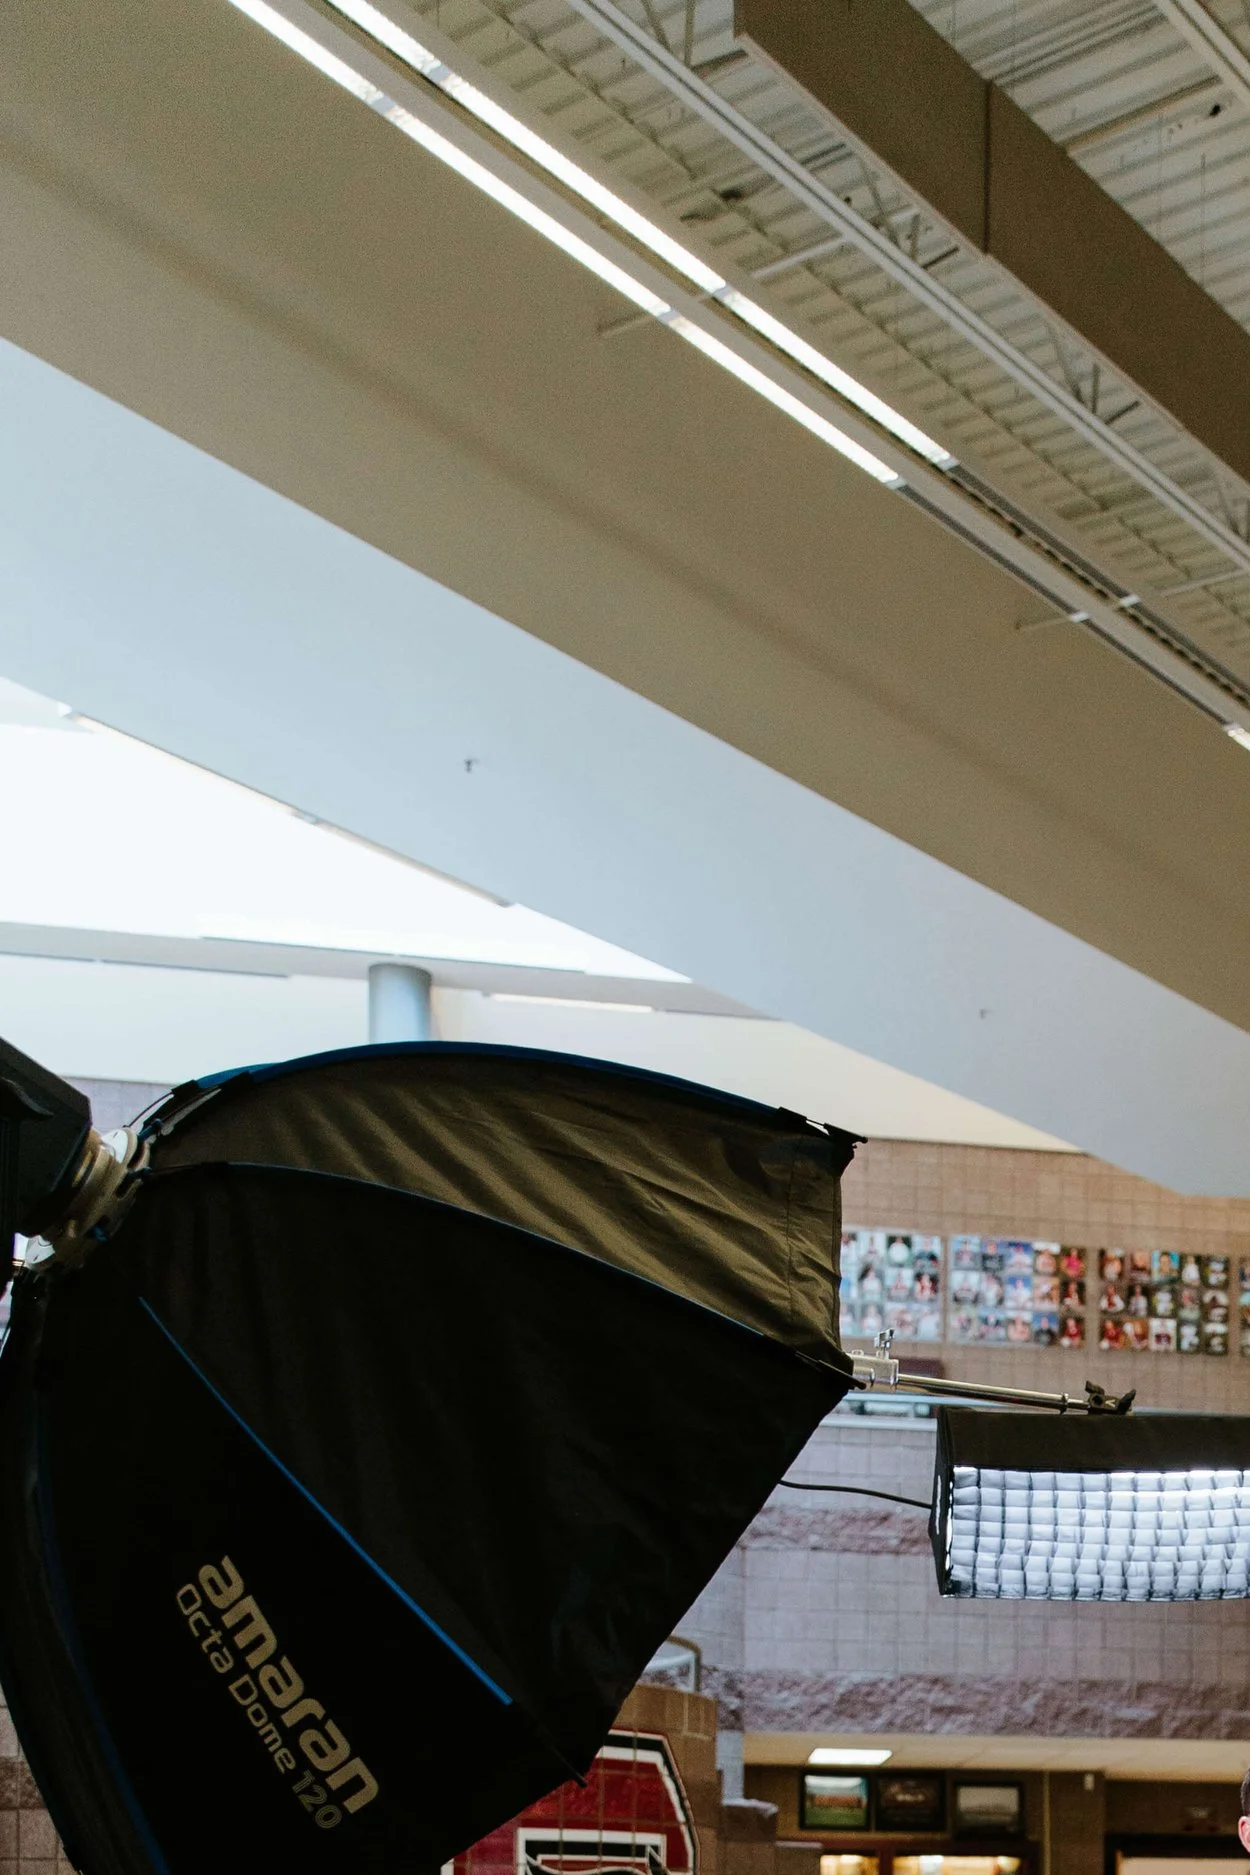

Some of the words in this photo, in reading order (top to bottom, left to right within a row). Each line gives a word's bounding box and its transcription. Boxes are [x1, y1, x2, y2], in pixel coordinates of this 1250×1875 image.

[176, 1583, 235, 1674] Octa
[228, 1674, 296, 1774] Dome
[292, 1770, 343, 1829] 120
[198, 1555, 379, 1814] amaran
